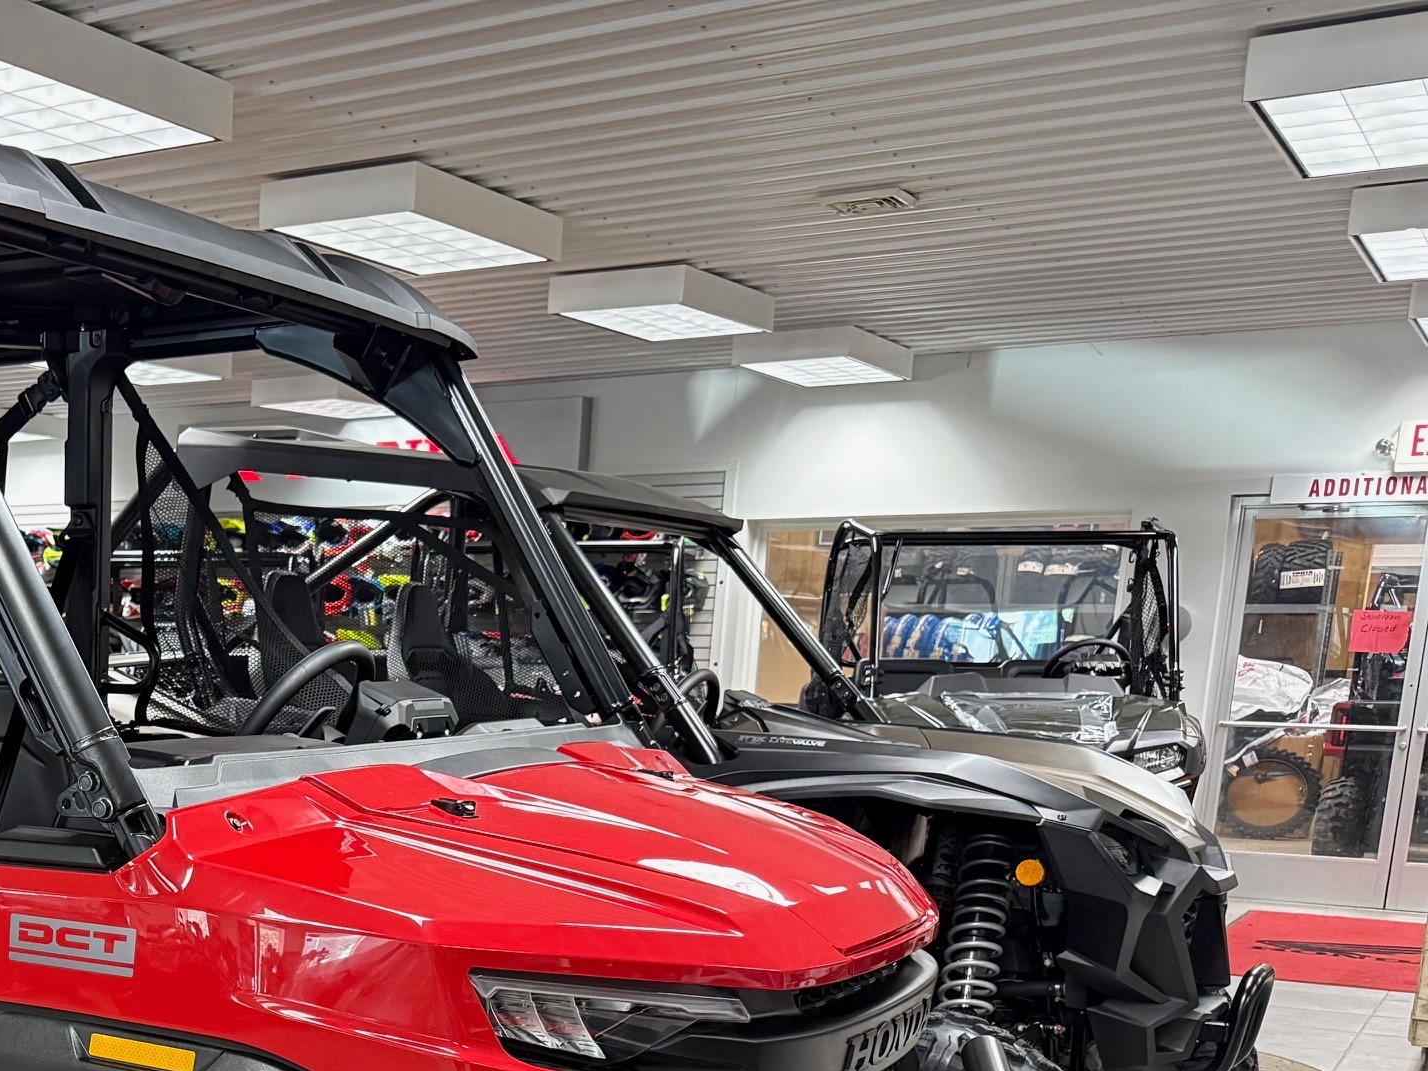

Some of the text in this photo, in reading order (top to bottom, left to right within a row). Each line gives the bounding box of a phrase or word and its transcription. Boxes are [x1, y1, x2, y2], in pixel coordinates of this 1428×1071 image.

[1411, 424, 1428, 456] E
[1308, 475, 1428, 498] ADDITIONA
[1360, 624, 1398, 633] Closed
[17, 921, 128, 954] DCT
